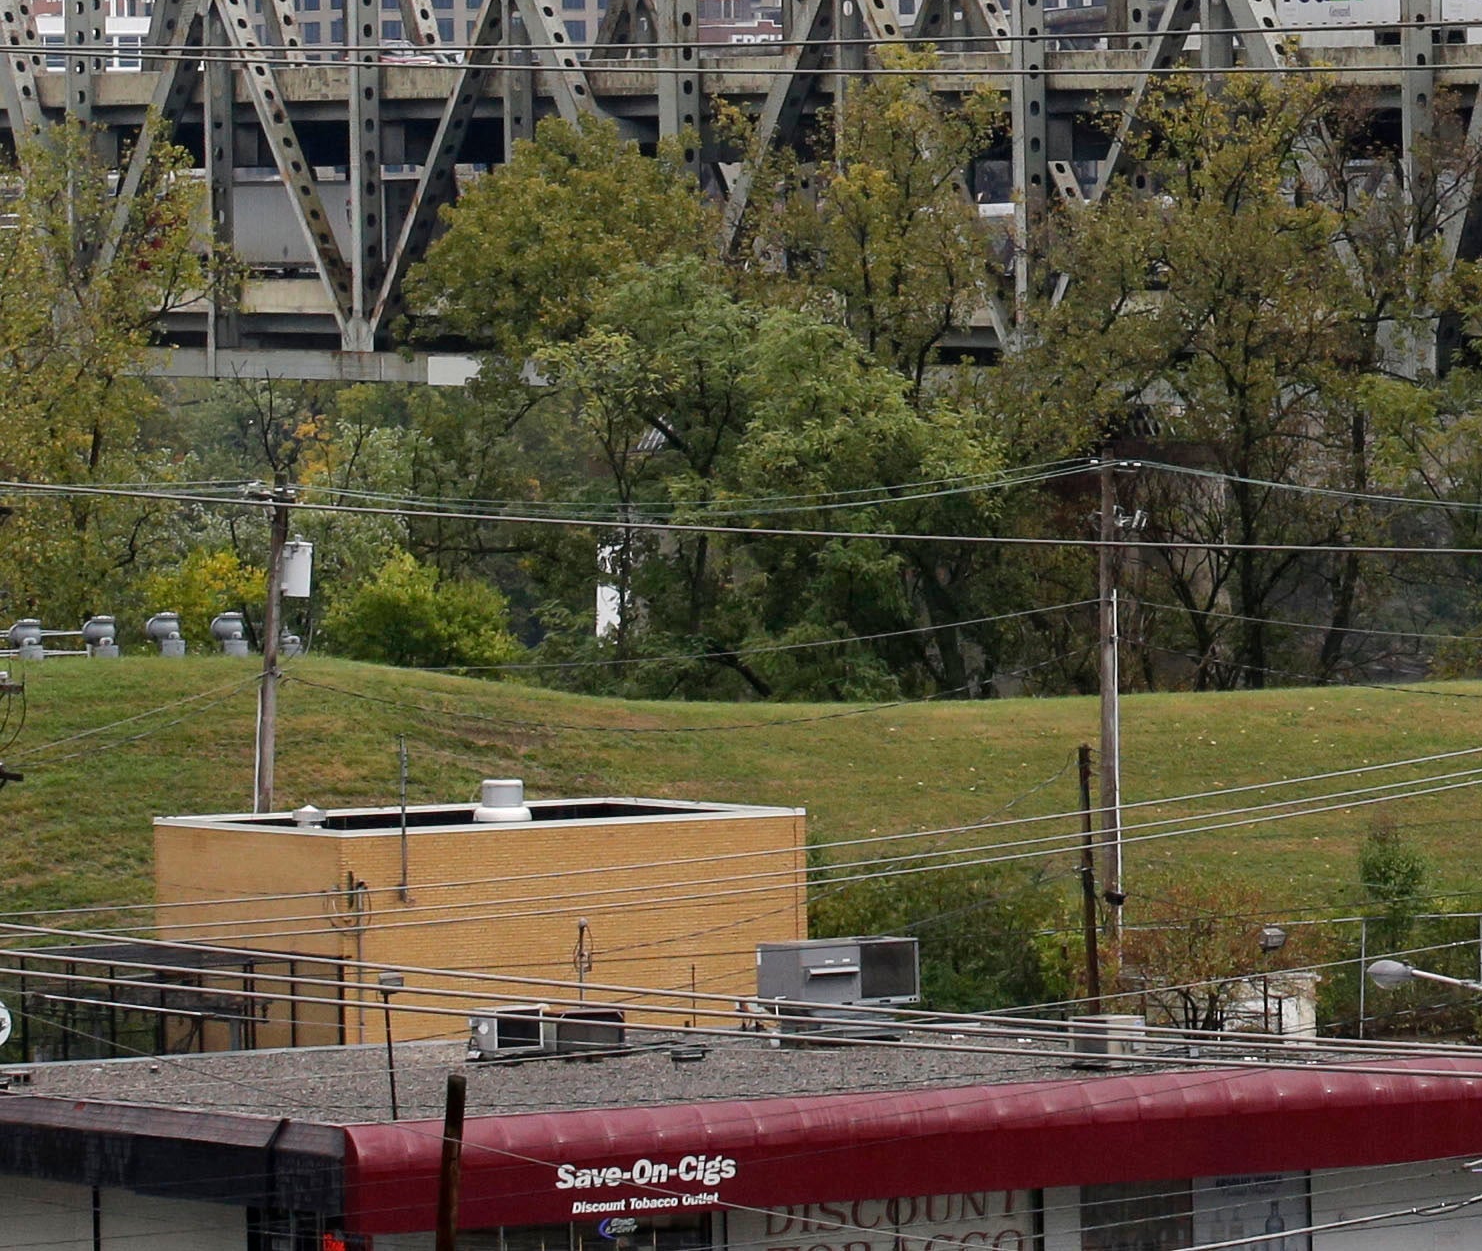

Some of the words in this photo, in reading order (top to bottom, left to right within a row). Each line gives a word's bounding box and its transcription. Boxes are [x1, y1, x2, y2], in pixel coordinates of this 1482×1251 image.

[555, 1155, 737, 1190] Save-On-Cigs
[572, 1198, 626, 1214] Discount
[629, 1196, 679, 1210] Tobacco
[681, 1191, 720, 1207] Outlet
[765, 1189, 1019, 1236] DISCOUNT
